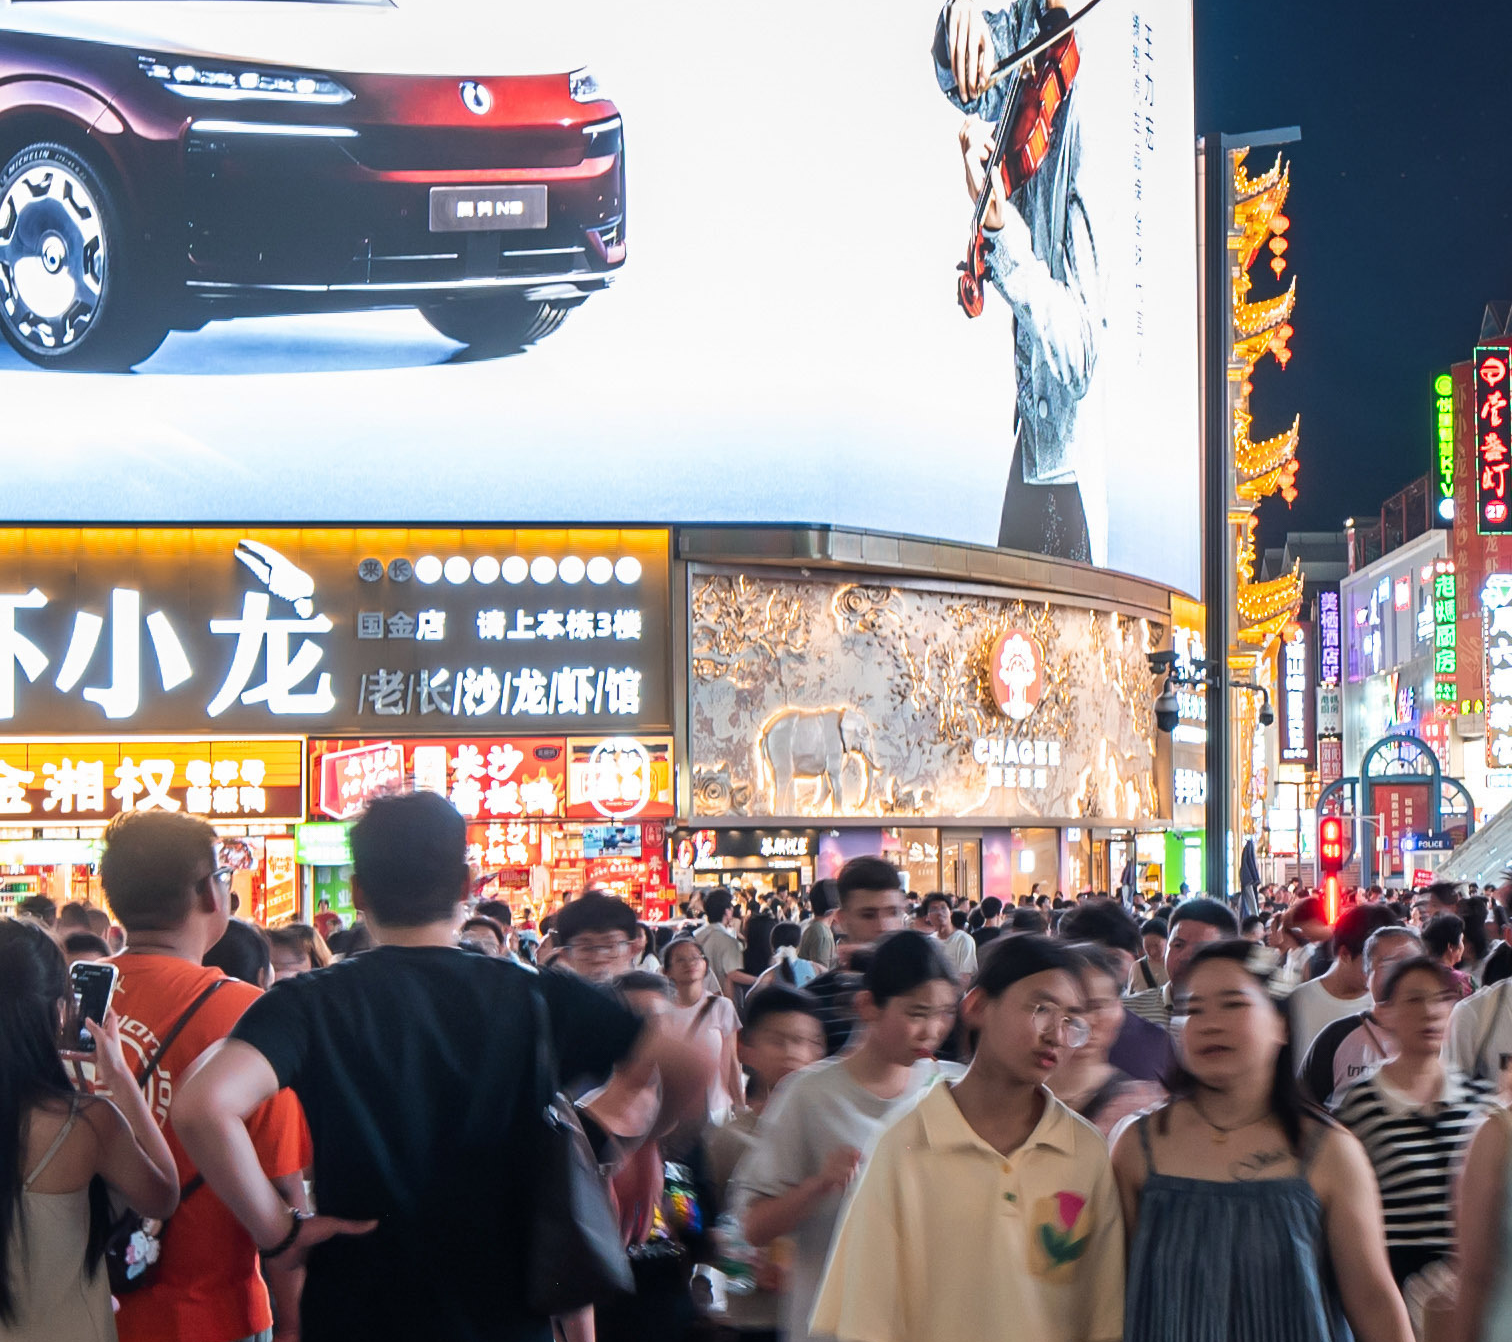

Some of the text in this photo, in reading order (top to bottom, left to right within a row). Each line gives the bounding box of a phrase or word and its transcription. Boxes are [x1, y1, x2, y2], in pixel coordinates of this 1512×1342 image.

[8, 149, 50, 175] MICHELIN
[357, 610, 642, 642] 国金店 请上本栋3楼
[972, 737, 1061, 767] CHAGEE
[1417, 839, 1444, 850] POLICE
